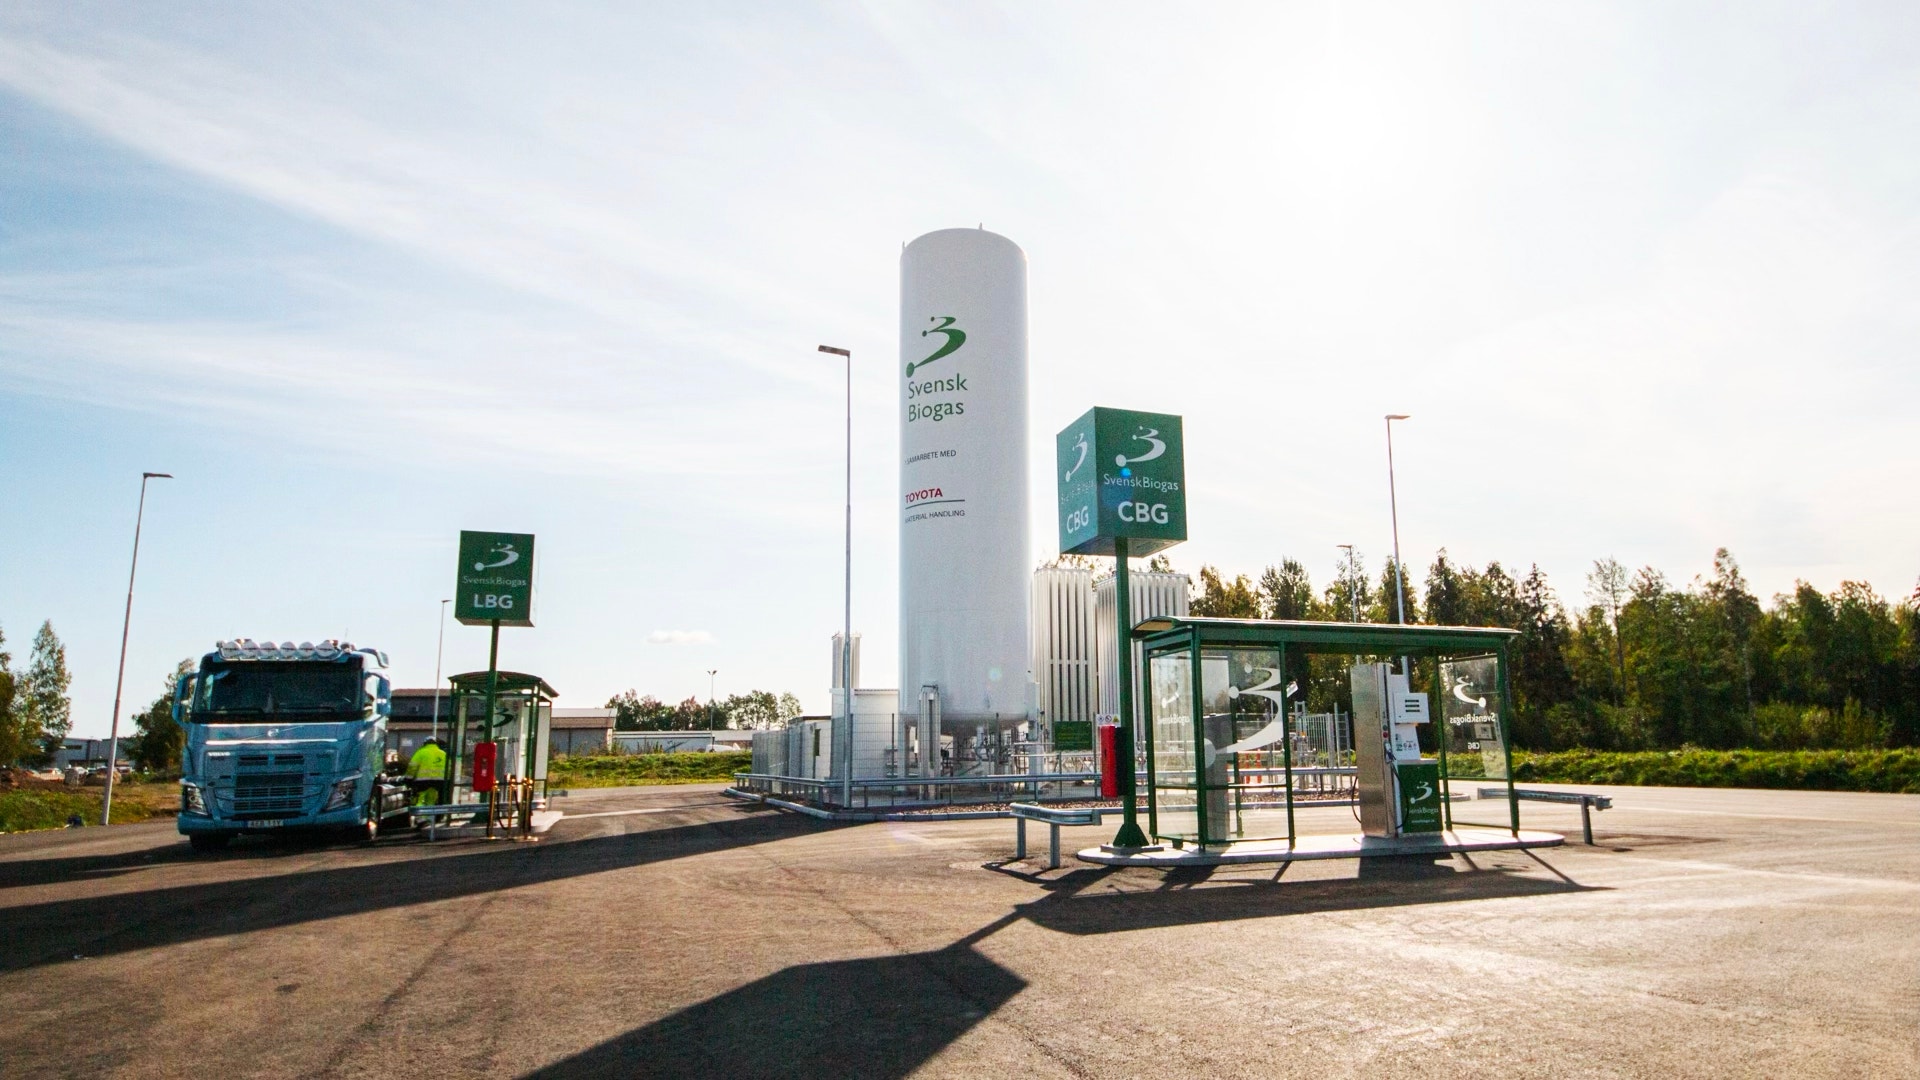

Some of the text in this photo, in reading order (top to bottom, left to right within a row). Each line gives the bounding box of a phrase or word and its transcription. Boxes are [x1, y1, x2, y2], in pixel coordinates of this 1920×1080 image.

[908, 373, 968, 399] Svensk
[908, 402, 964, 422] Biogas
[906, 449, 957, 464] SAMARBETE MED
[1103, 473, 1179, 493] SvenskBiogas
[905, 488, 943, 503] TOYOTA
[929, 510, 966, 518] HANDLING
[1066, 505, 1089, 534] CBG
[1117, 501, 1169, 524] CBG
[462, 575, 527, 587] SvenskBiogas
[473, 594, 513, 609] LBG
